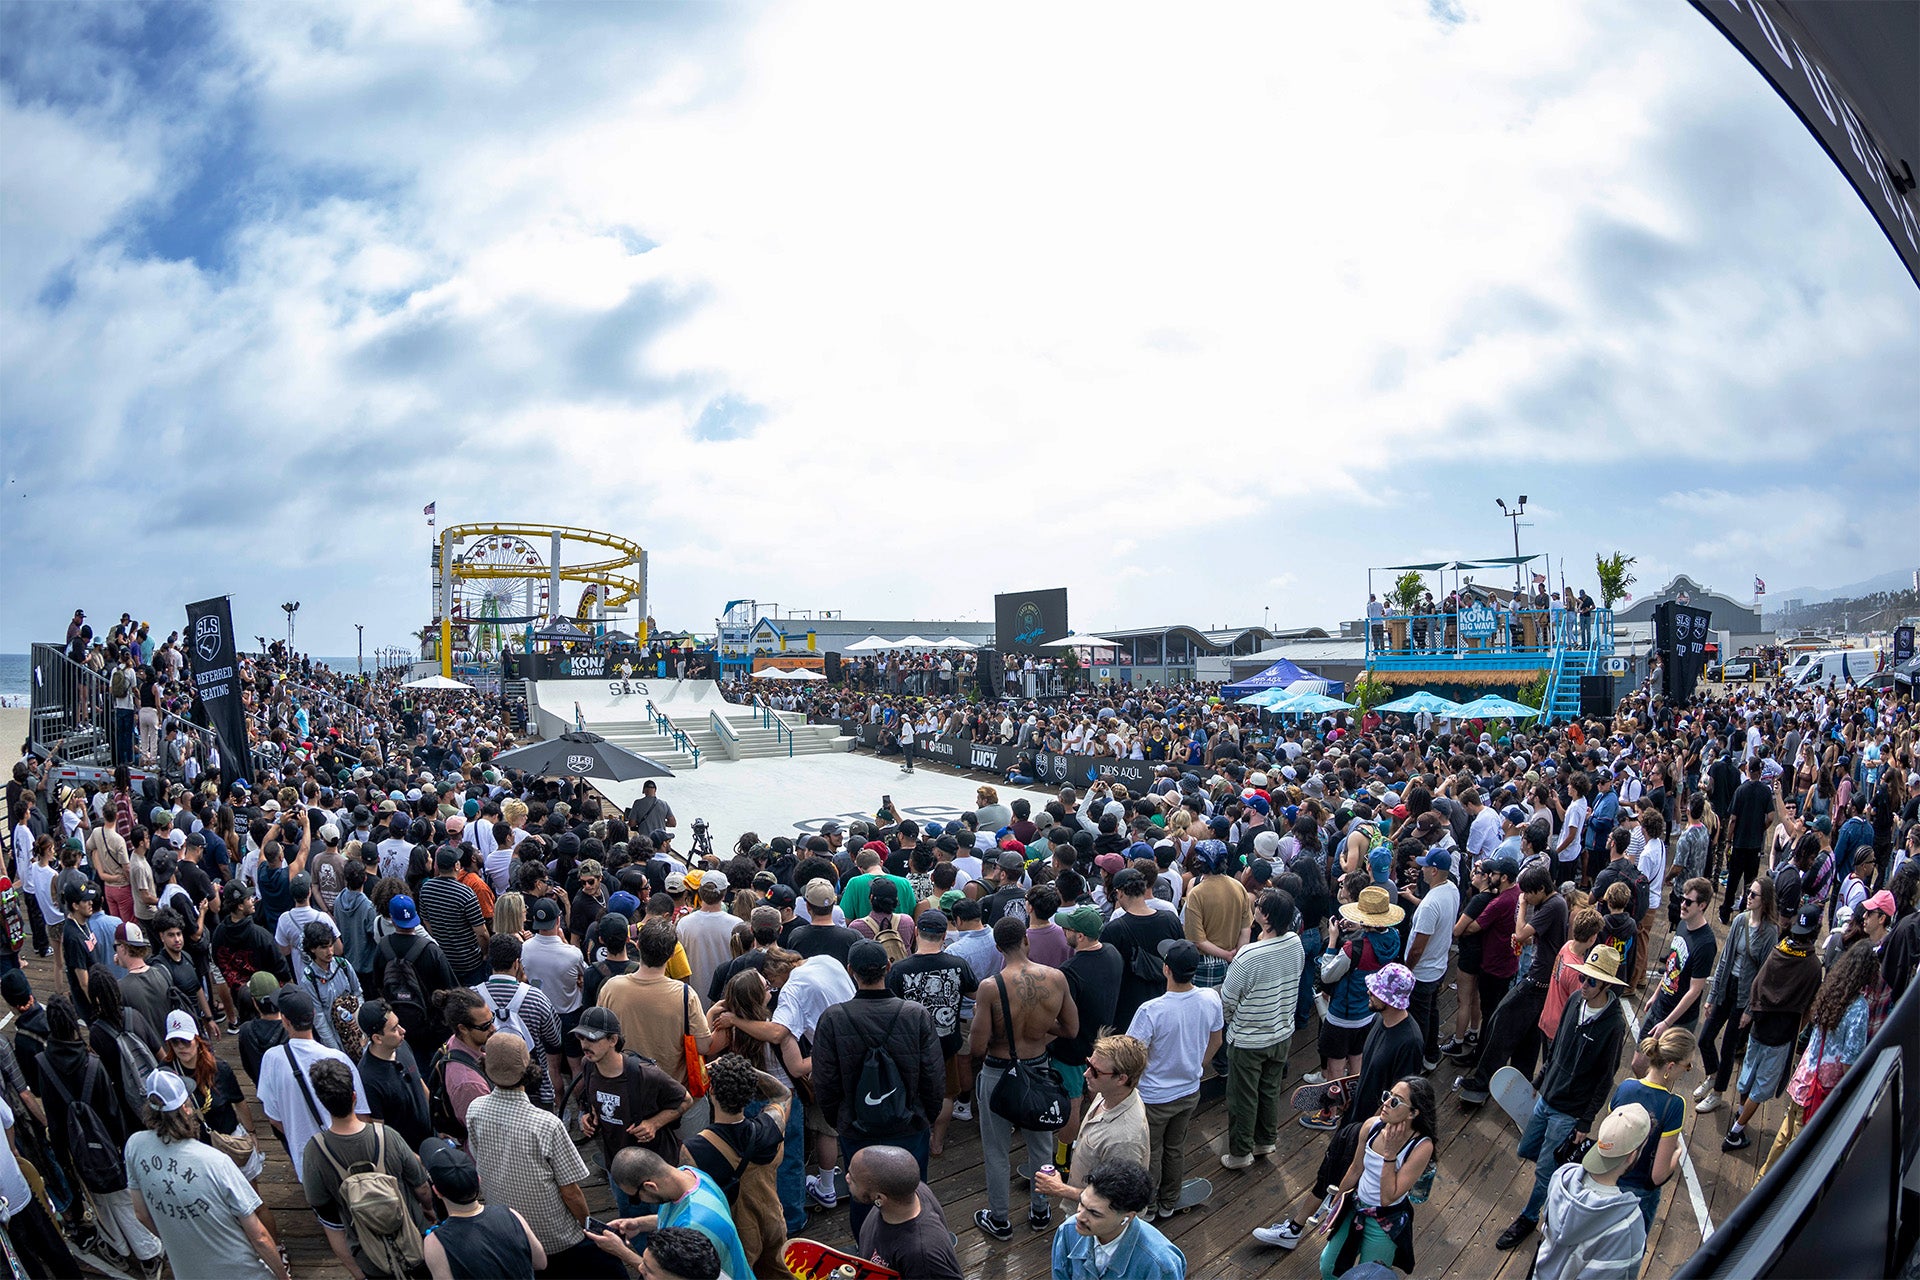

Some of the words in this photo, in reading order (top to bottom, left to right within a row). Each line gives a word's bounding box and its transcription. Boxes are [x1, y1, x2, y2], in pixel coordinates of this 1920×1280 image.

[197, 618, 218, 637] SLS
[1474, 622, 1496, 630] WAVE
[1676, 615, 1690, 628] SLS
[1694, 617, 1706, 627] SLS
[1691, 642, 1703, 654] VIP
[571, 668, 585, 676] BIG
[586, 668, 604, 676] WAV
[200, 684, 229, 702] SEATING
[935, 743, 953, 756] HEALTH
[571, 756, 591, 764] SLS
[1036, 754, 1047, 765] SLS
[1054, 756, 1067, 767] SLS
[1100, 764, 1119, 776] DIOS
[140, 1154, 198, 1184] BORN
